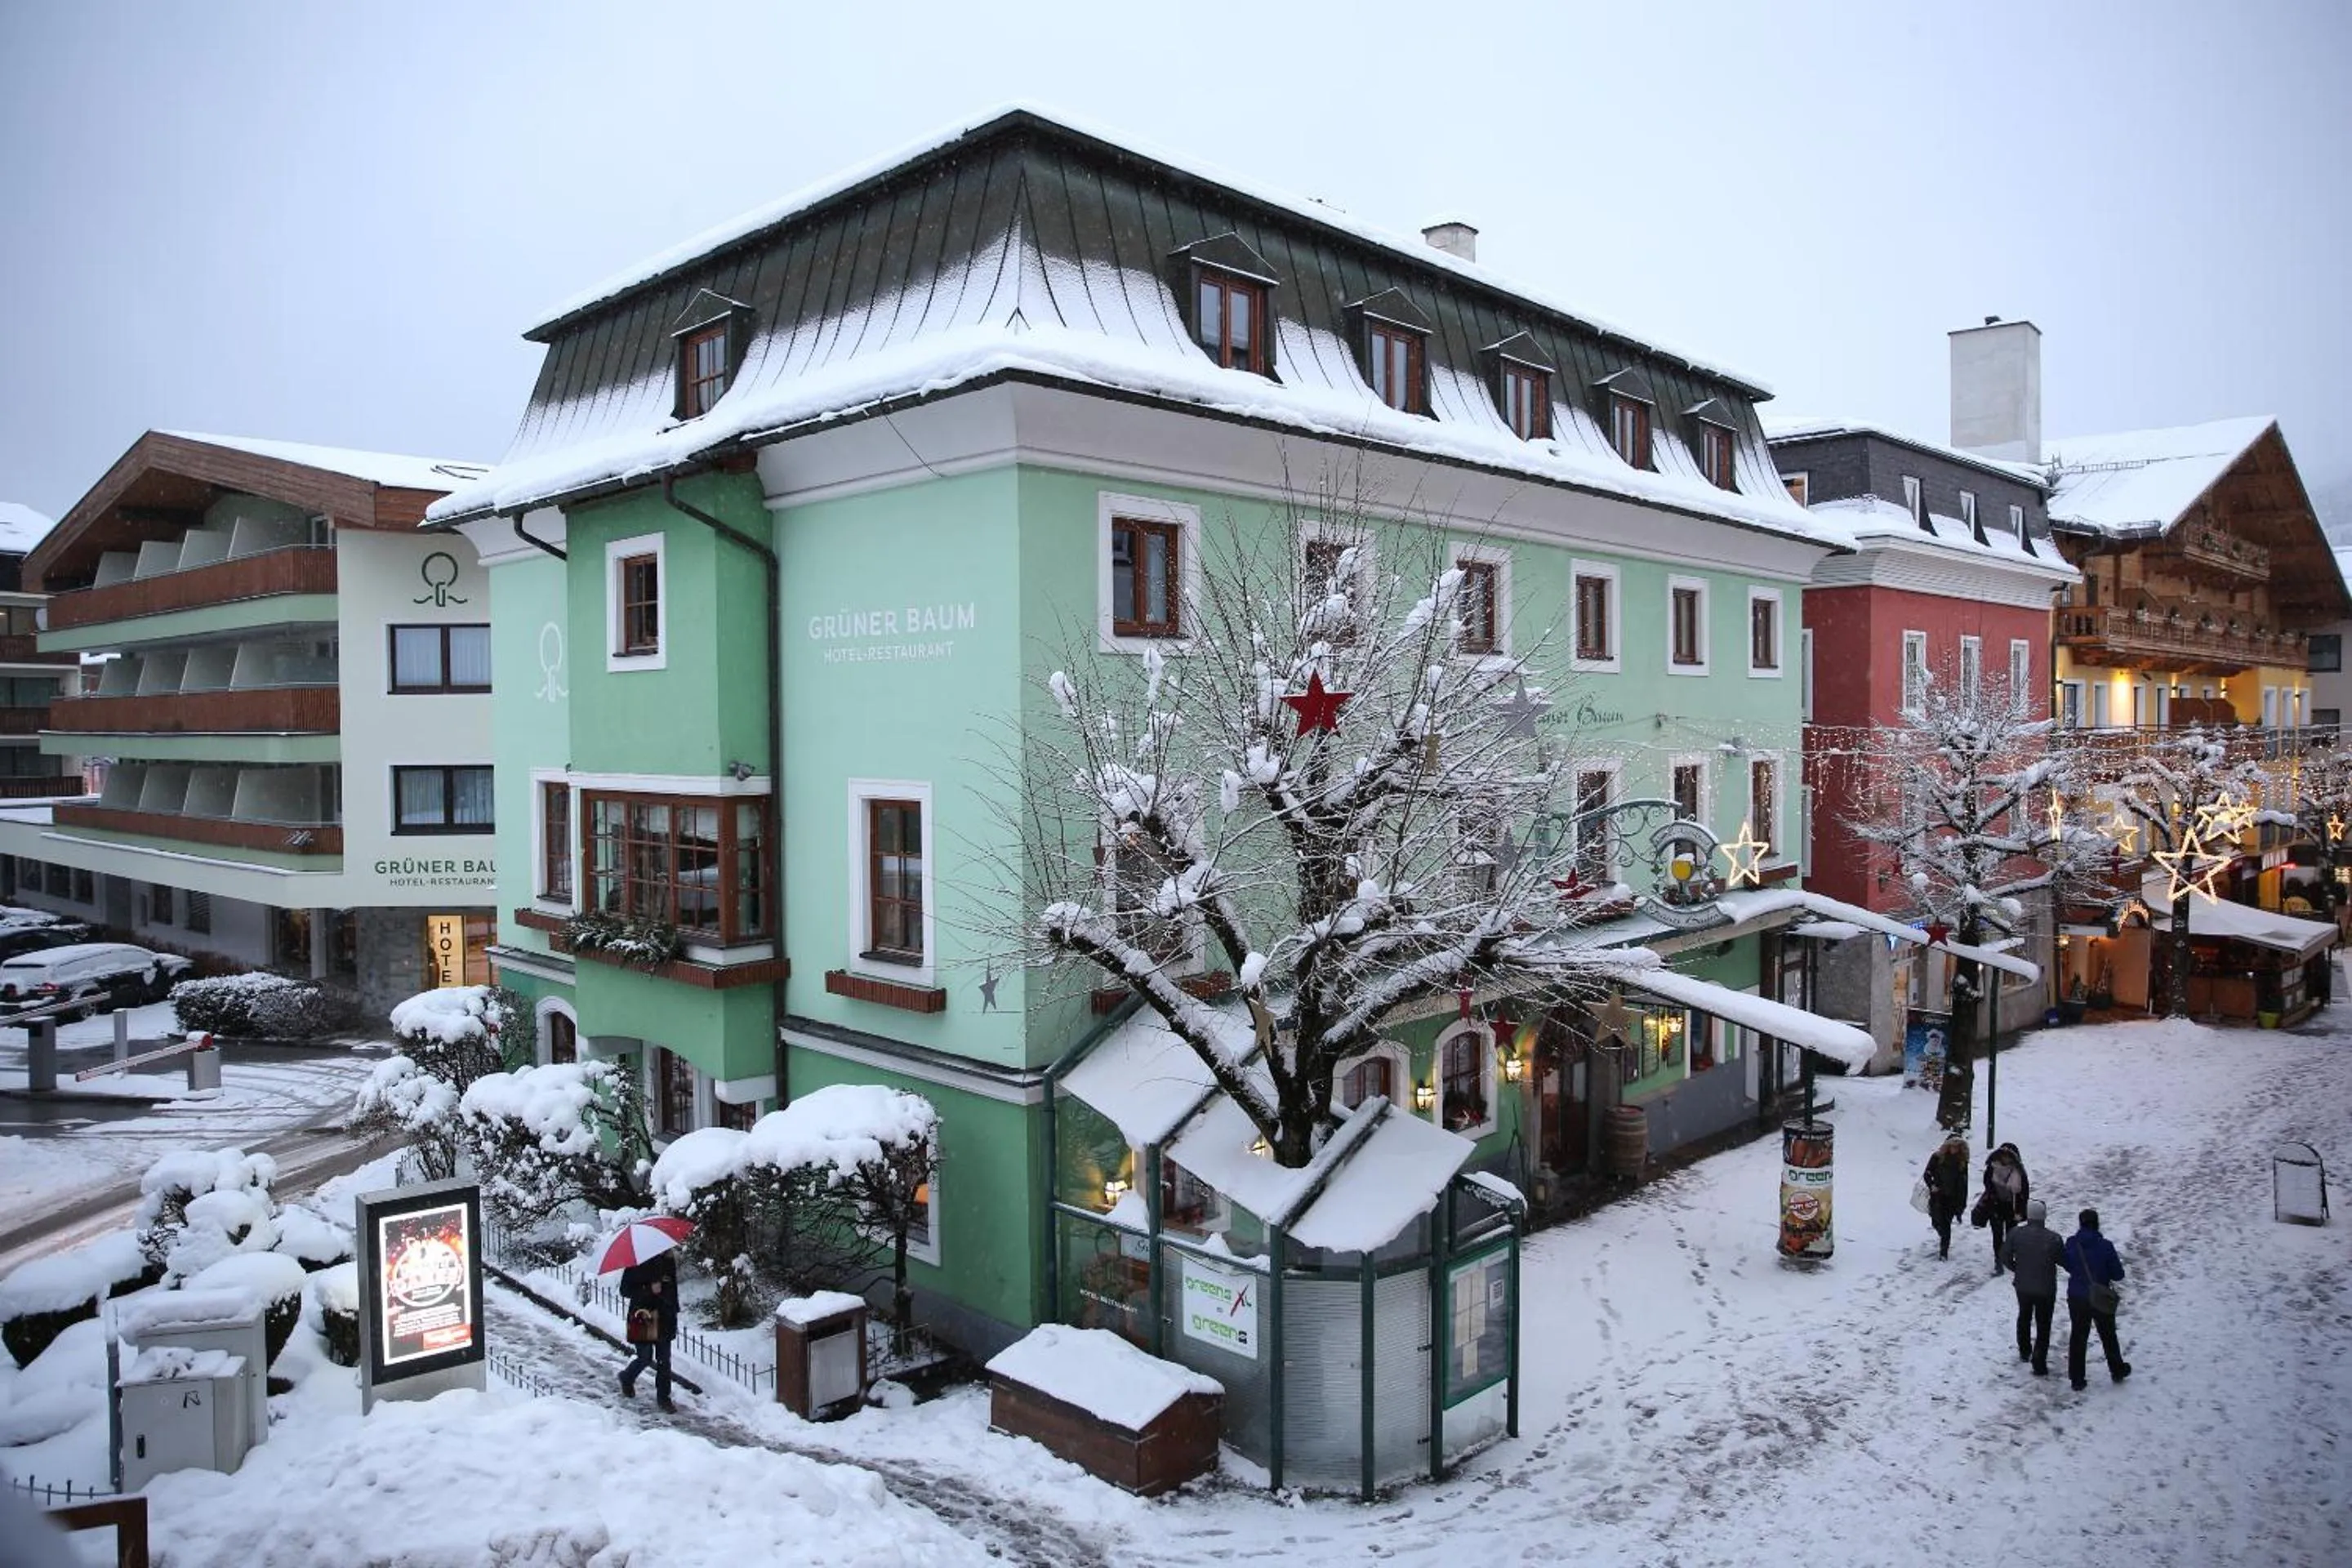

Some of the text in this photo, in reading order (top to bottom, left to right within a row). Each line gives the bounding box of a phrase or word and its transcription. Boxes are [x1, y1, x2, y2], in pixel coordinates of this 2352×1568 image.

[808, 602, 974, 639] GRÜNER BAUM
[374, 858, 496, 874] GRÜNER BAU
[390, 877, 495, 887] HOTEL-RESTAURAN
[439, 921, 452, 983] HOTE
[1788, 1169, 1833, 1182] green
[1185, 1276, 1232, 1300] greens
[1192, 1314, 1248, 1345] greens
